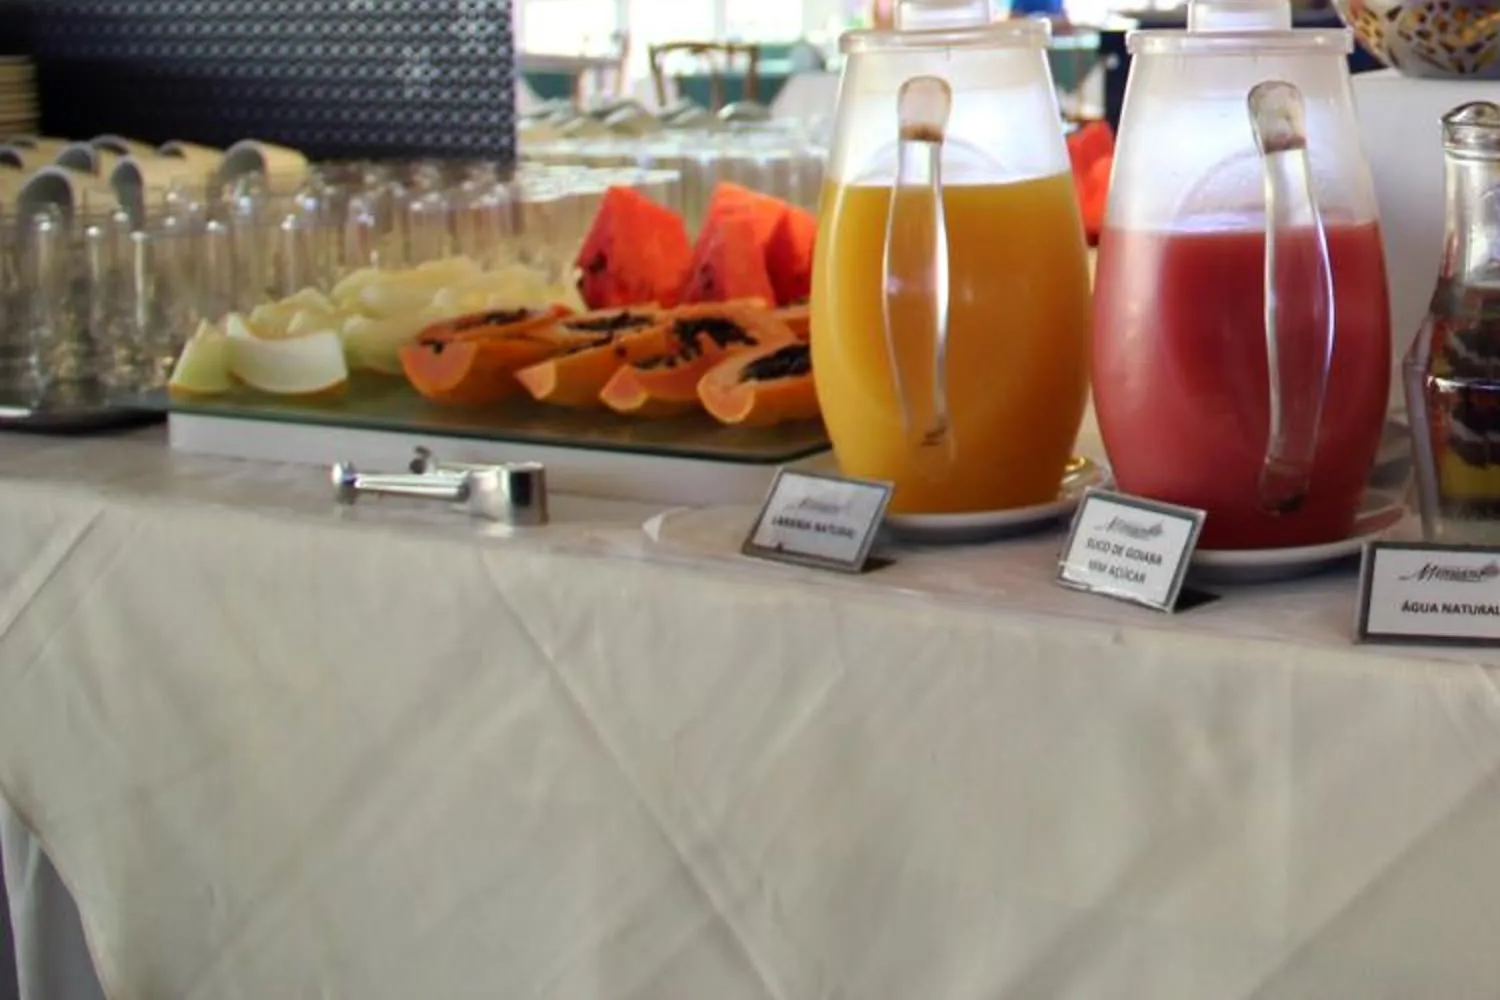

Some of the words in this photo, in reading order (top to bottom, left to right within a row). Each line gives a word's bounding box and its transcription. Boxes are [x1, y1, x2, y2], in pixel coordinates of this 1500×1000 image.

[1110, 543, 1124, 558] DE
[1401, 600, 1439, 614] ÁGUA
[1441, 602, 1500, 616] NATURAL
